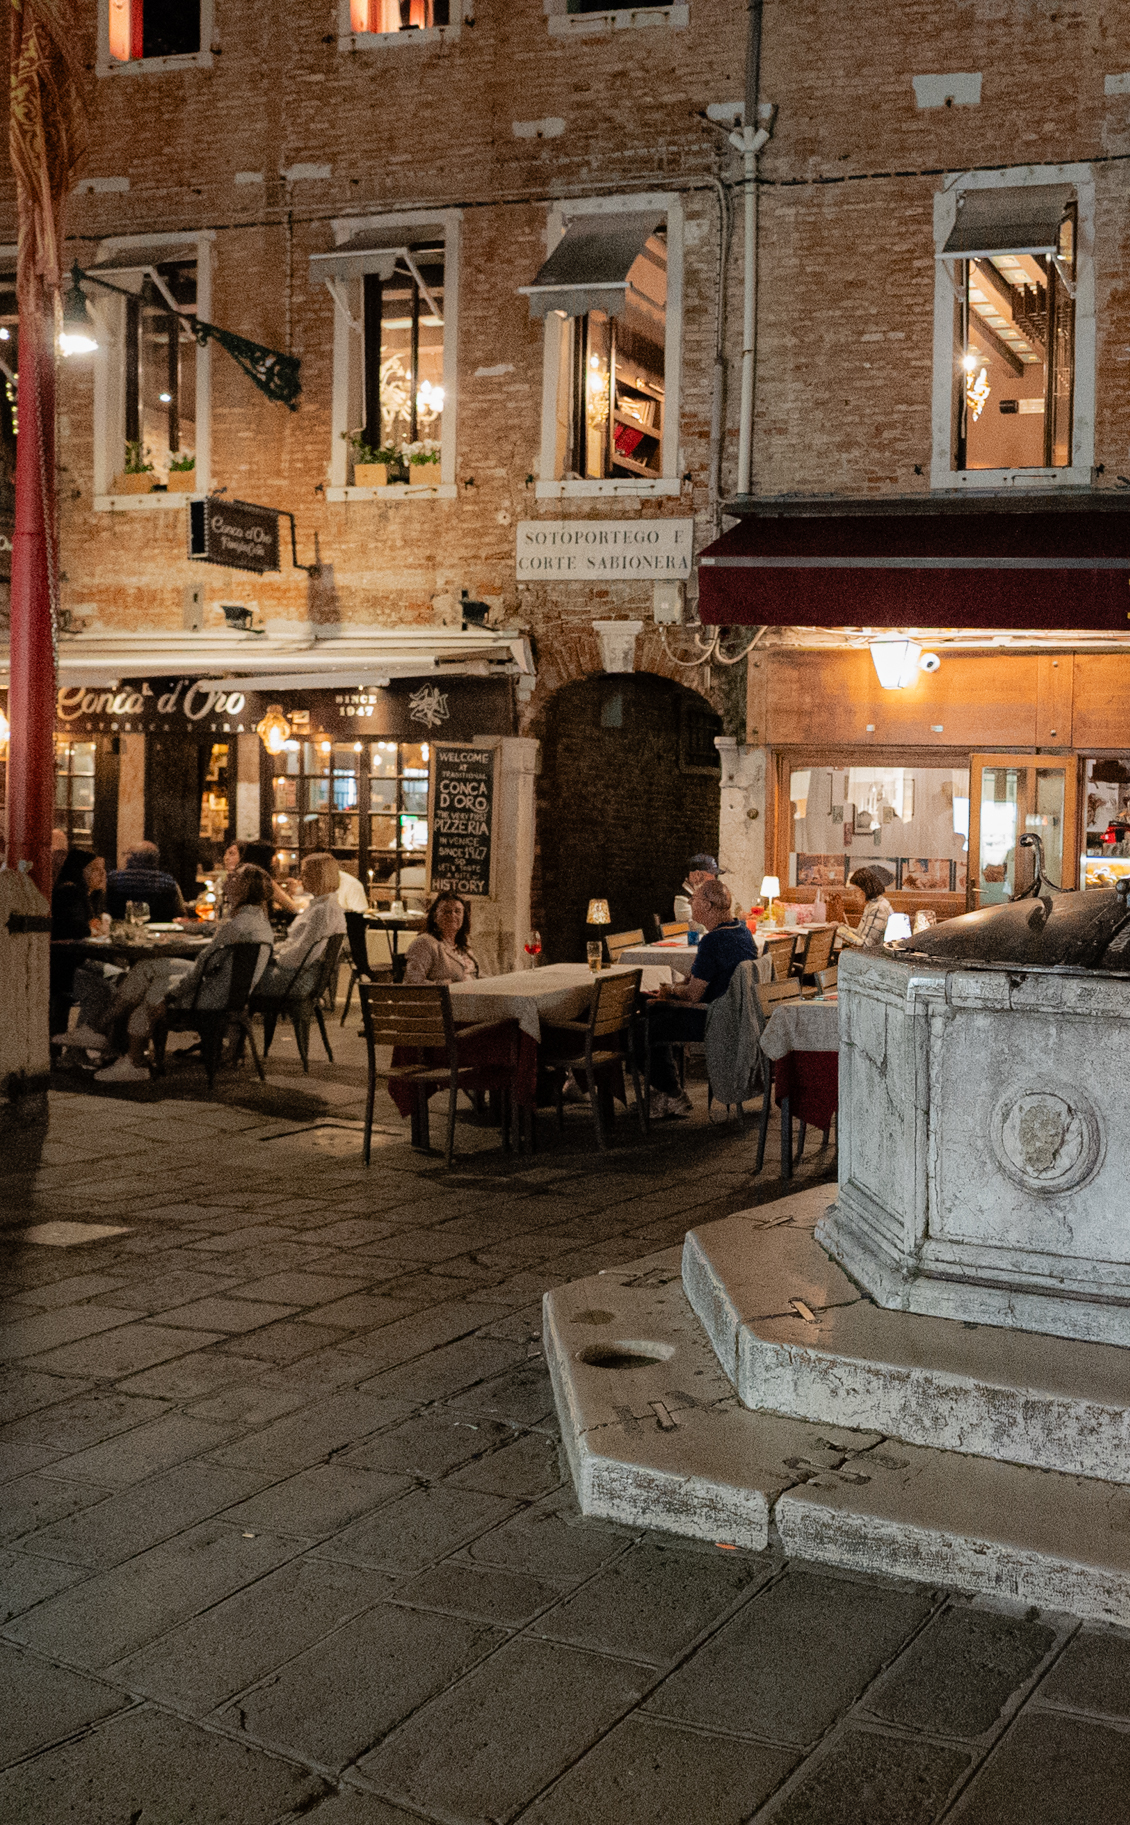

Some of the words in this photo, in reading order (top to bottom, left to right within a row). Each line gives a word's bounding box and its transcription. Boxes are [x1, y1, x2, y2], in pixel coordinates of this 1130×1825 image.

[525, 530, 660, 545] SOTOPORTEGO
[674, 529, 684, 544] E
[518, 556, 577, 570] CORTE
[586, 555, 688, 570] SABIONERA
[335, 694, 378, 704] SINCE
[339, 706, 375, 717] 1947
[439, 752, 489, 764] WELCOME
[440, 780, 488, 796] CONCA
[440, 793, 489, 813] D'ORO
[434, 818, 489, 836] PIZZERIA
[448, 836, 480, 847] VENICE
[438, 846, 465, 858] SINCE
[432, 878, 485, 893] HISTORY
